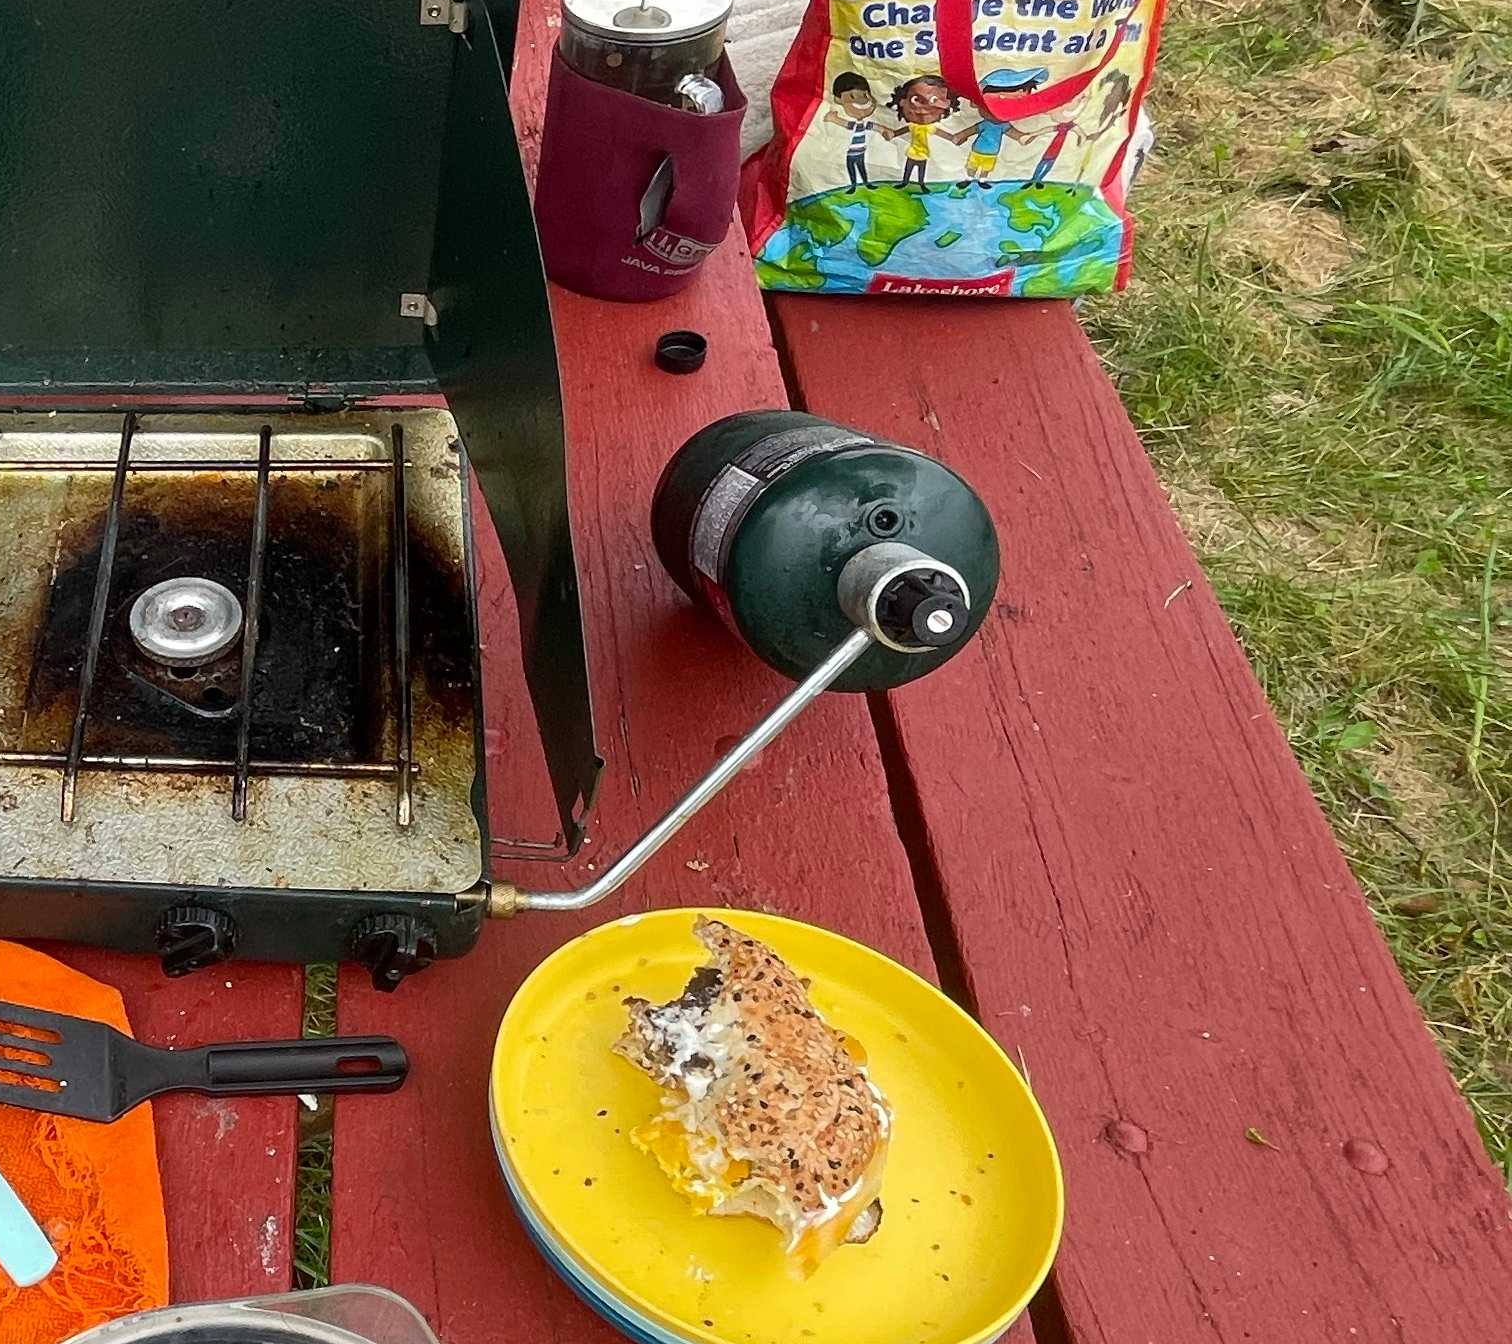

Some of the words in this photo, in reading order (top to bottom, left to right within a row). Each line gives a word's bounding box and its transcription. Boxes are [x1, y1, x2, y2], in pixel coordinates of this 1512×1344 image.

[849, 35, 905, 58] One
[914, 25, 1057, 57] Sdent
[1063, 29, 1094, 55] at
[1095, 28, 1108, 50] a
[620, 256, 661, 274] JAVA
